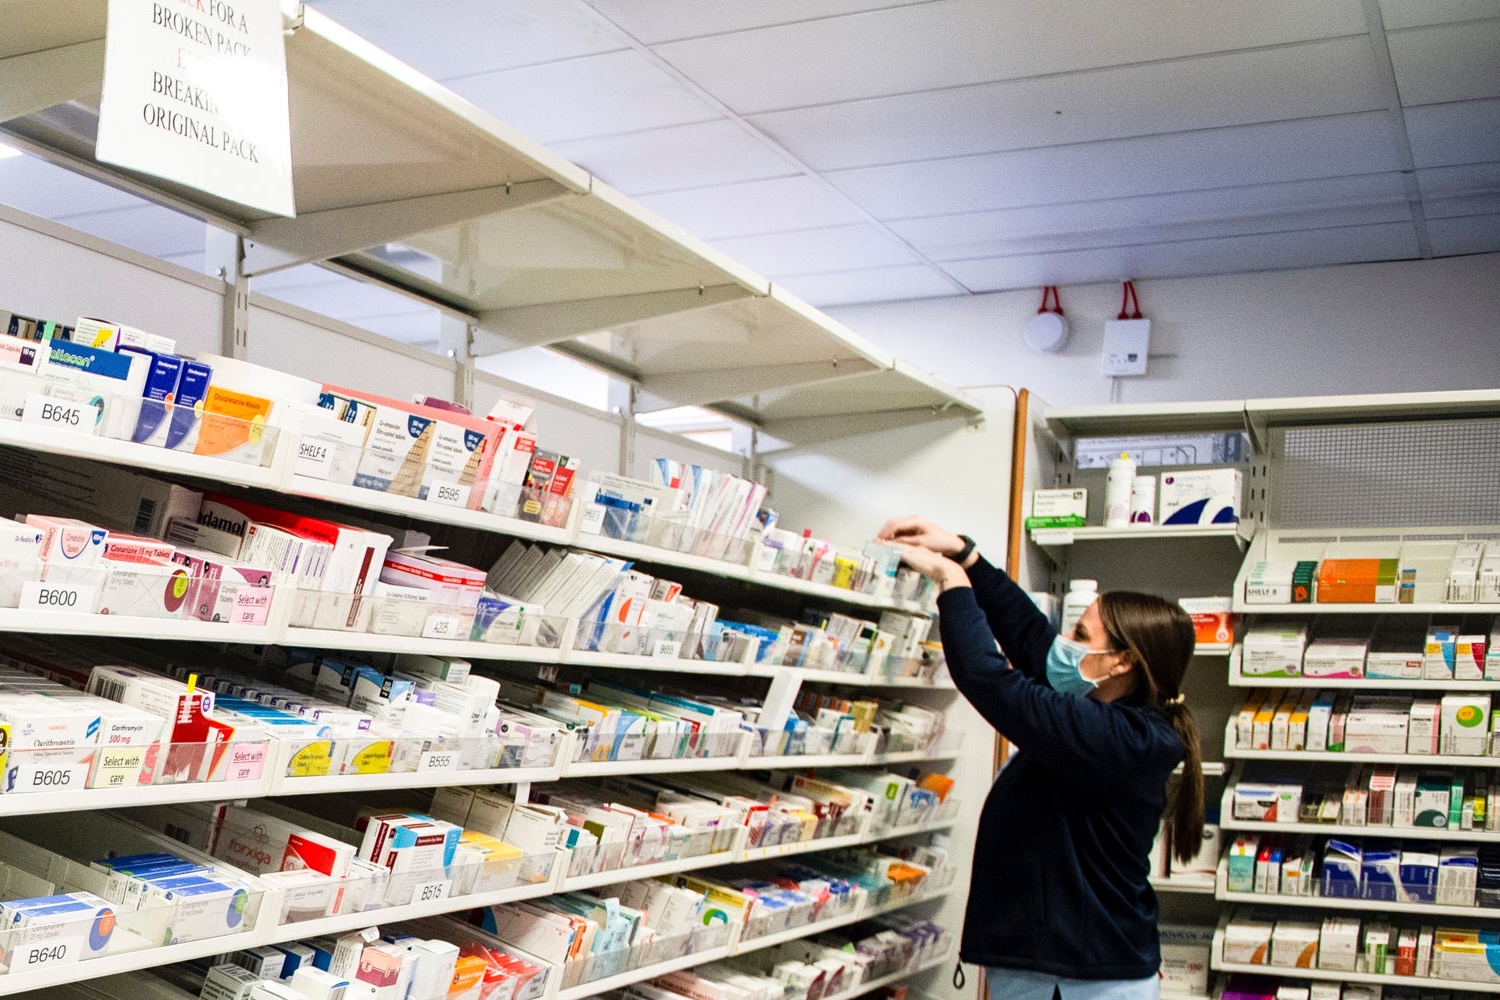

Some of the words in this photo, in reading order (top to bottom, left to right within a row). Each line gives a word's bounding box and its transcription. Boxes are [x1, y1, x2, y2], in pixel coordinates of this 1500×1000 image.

[153, 3, 213, 48] BROKEN
[210, 0, 235, 25] FOR
[239, 15, 248, 33] A
[143, 103, 218, 148] ORIGINAL
[223, 131, 259, 163] PACK
[41, 403, 81, 427] B645
[300, 443, 319, 458] SHELF
[320, 448, 327, 459] 4
[437, 486, 460, 502] B595
[38, 588, 77, 607] B600
[428, 755, 451, 768] B555
[33, 769, 71, 786] B605
[421, 884, 443, 901] B515
[28, 944, 67, 964] B640
